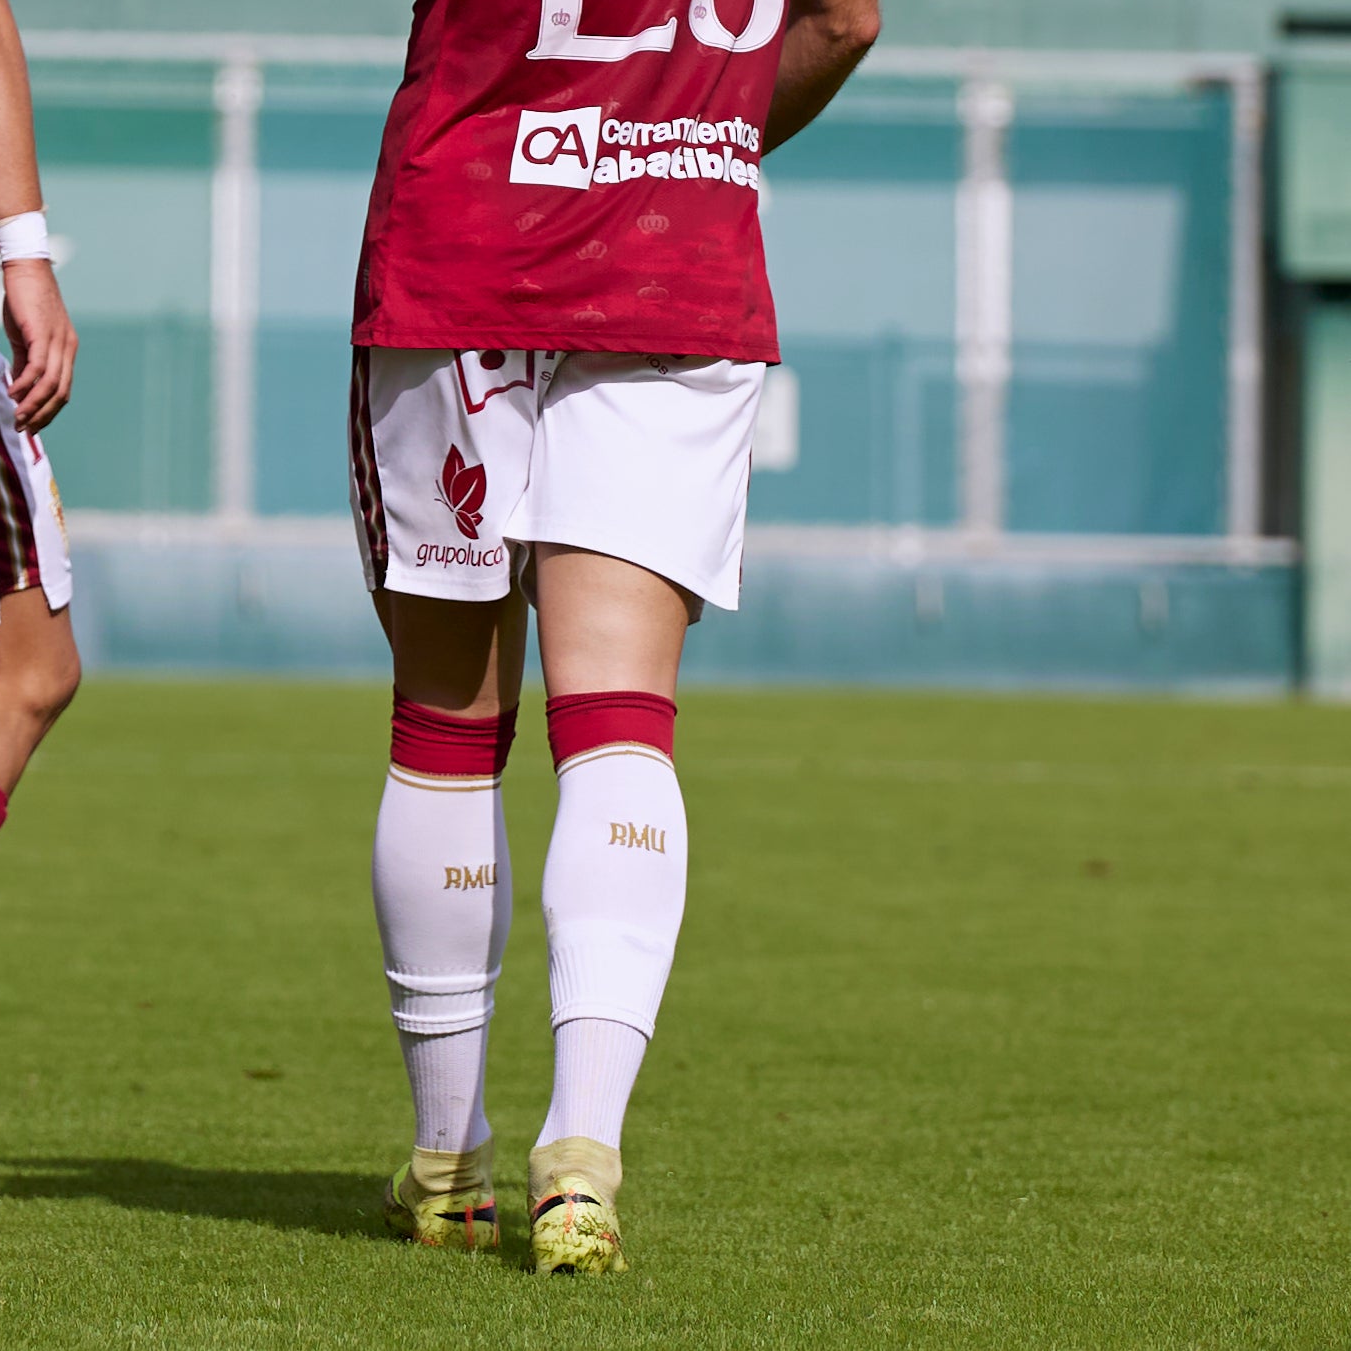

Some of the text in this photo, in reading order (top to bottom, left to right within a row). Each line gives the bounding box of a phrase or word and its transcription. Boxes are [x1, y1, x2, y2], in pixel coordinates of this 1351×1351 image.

[520, 124, 591, 167] CA
[601, 113, 760, 153] cerramientos
[592, 147, 760, 191] abatibles
[607, 821, 666, 855] RMU
[442, 862, 499, 892] RMU
